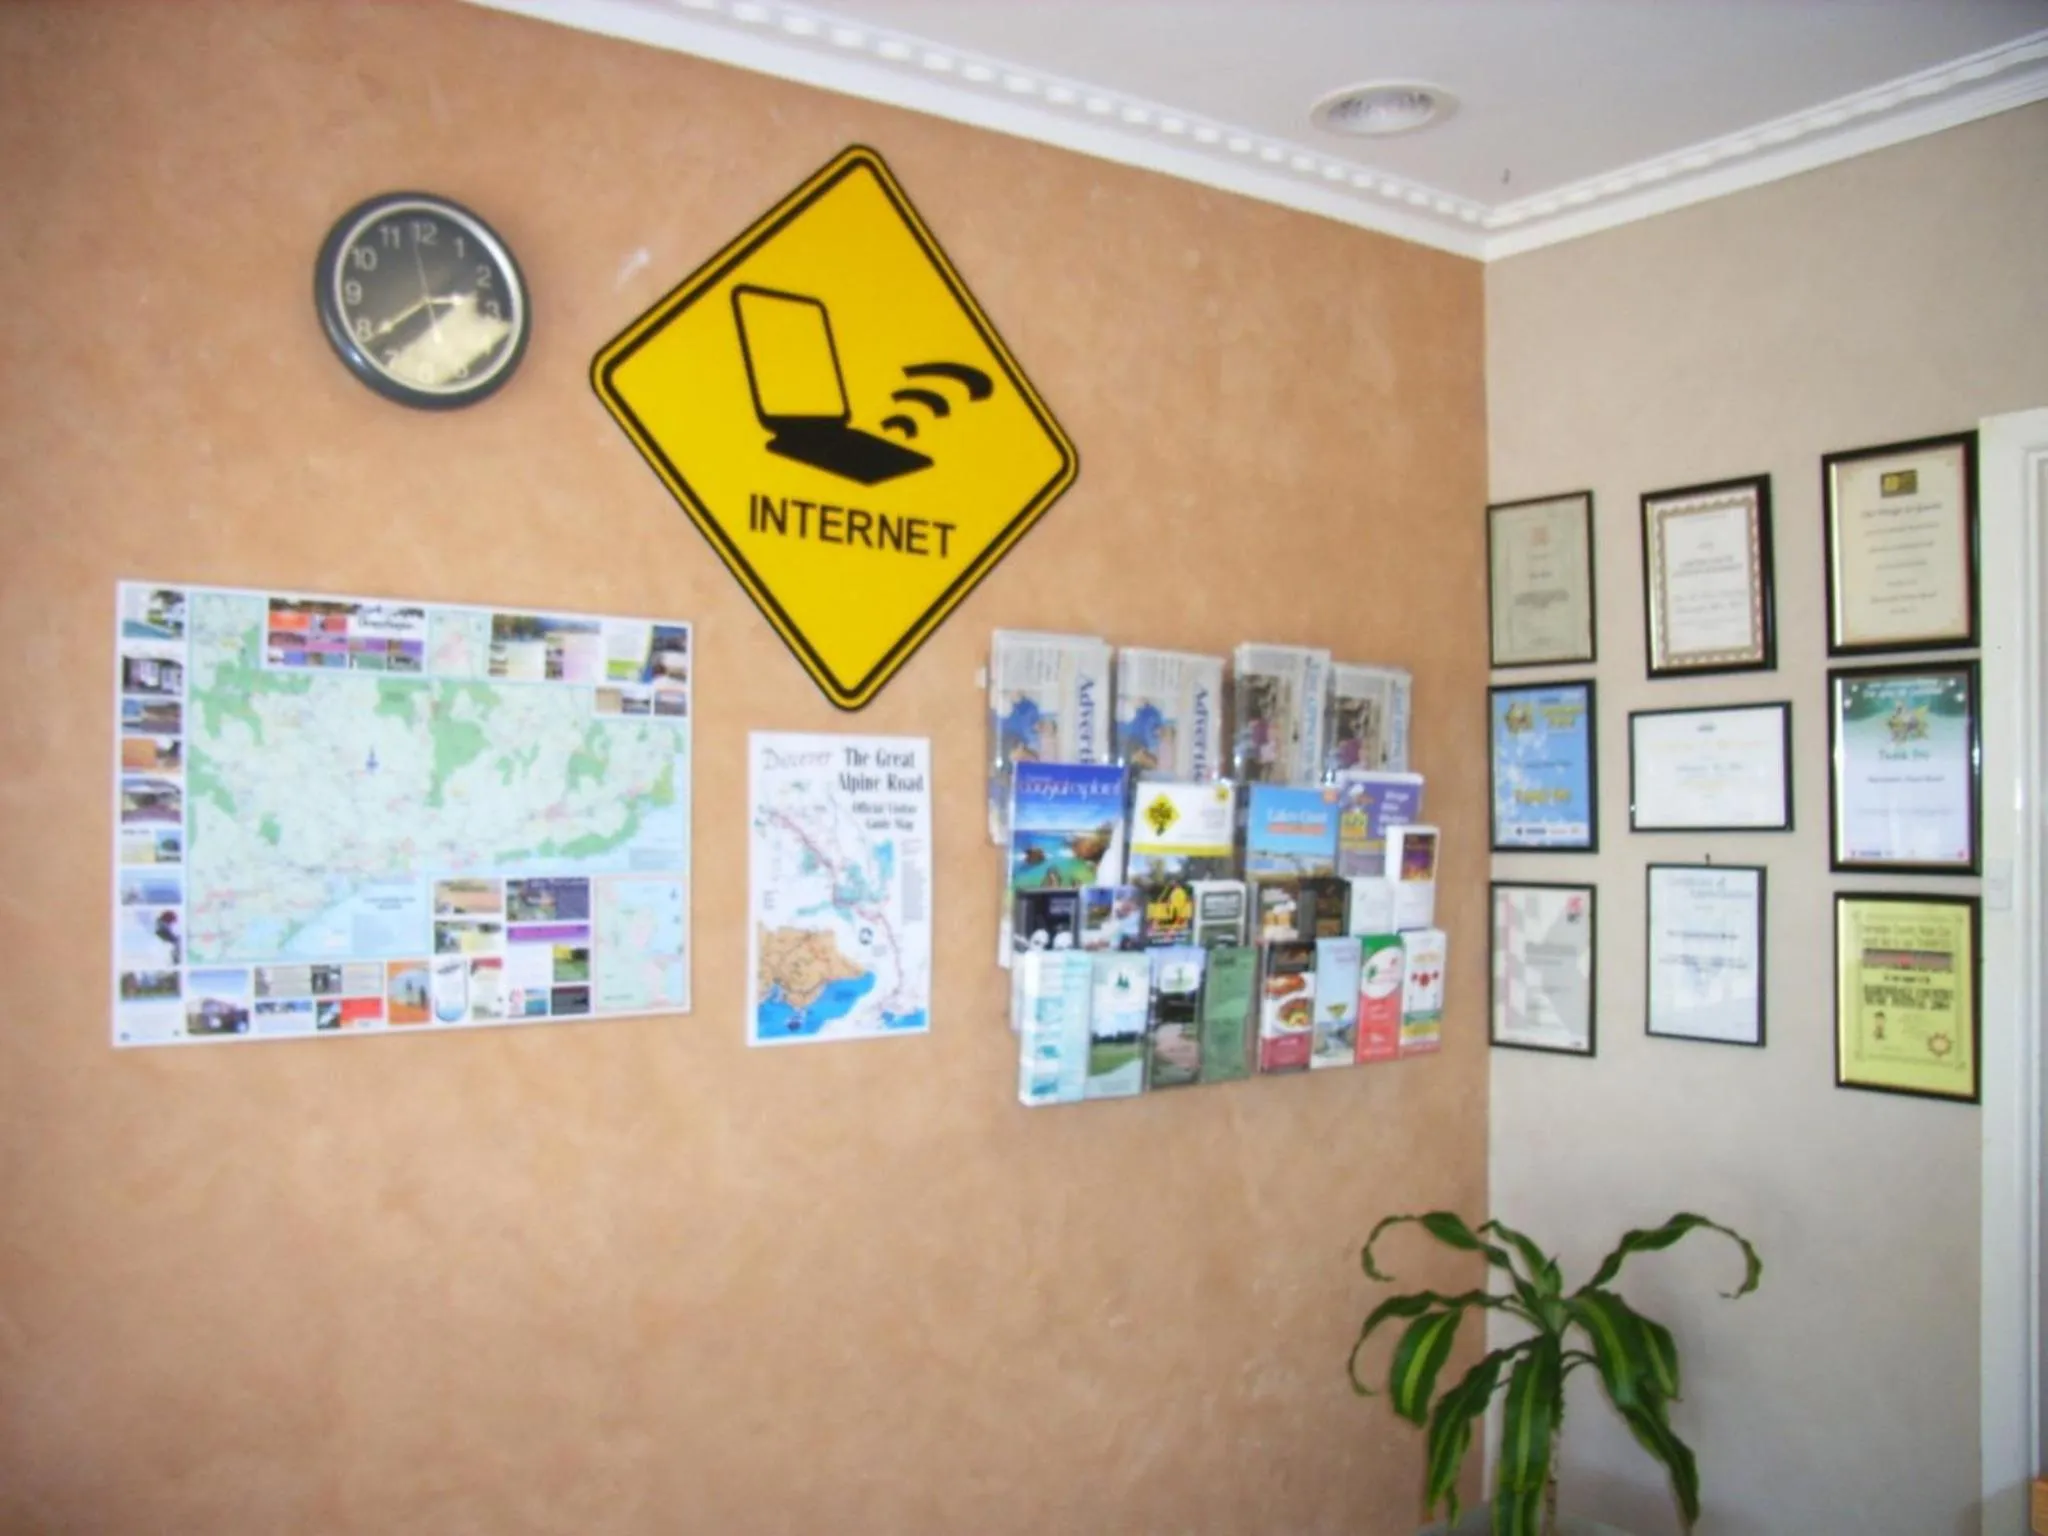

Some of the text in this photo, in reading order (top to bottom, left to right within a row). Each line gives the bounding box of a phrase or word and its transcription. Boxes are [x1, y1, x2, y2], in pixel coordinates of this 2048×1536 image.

[379, 225, 400, 249] 11
[411, 221, 438, 245] 12
[350, 246, 377, 272] 10
[454, 237, 465, 259] 1
[475, 265, 492, 288] 2
[345, 279, 362, 305] 9
[355, 318, 373, 341] 8
[750, 494, 957, 558] INTERNET
[845, 747, 915, 768] The Great
[838, 772, 923, 794] Alpine Road
